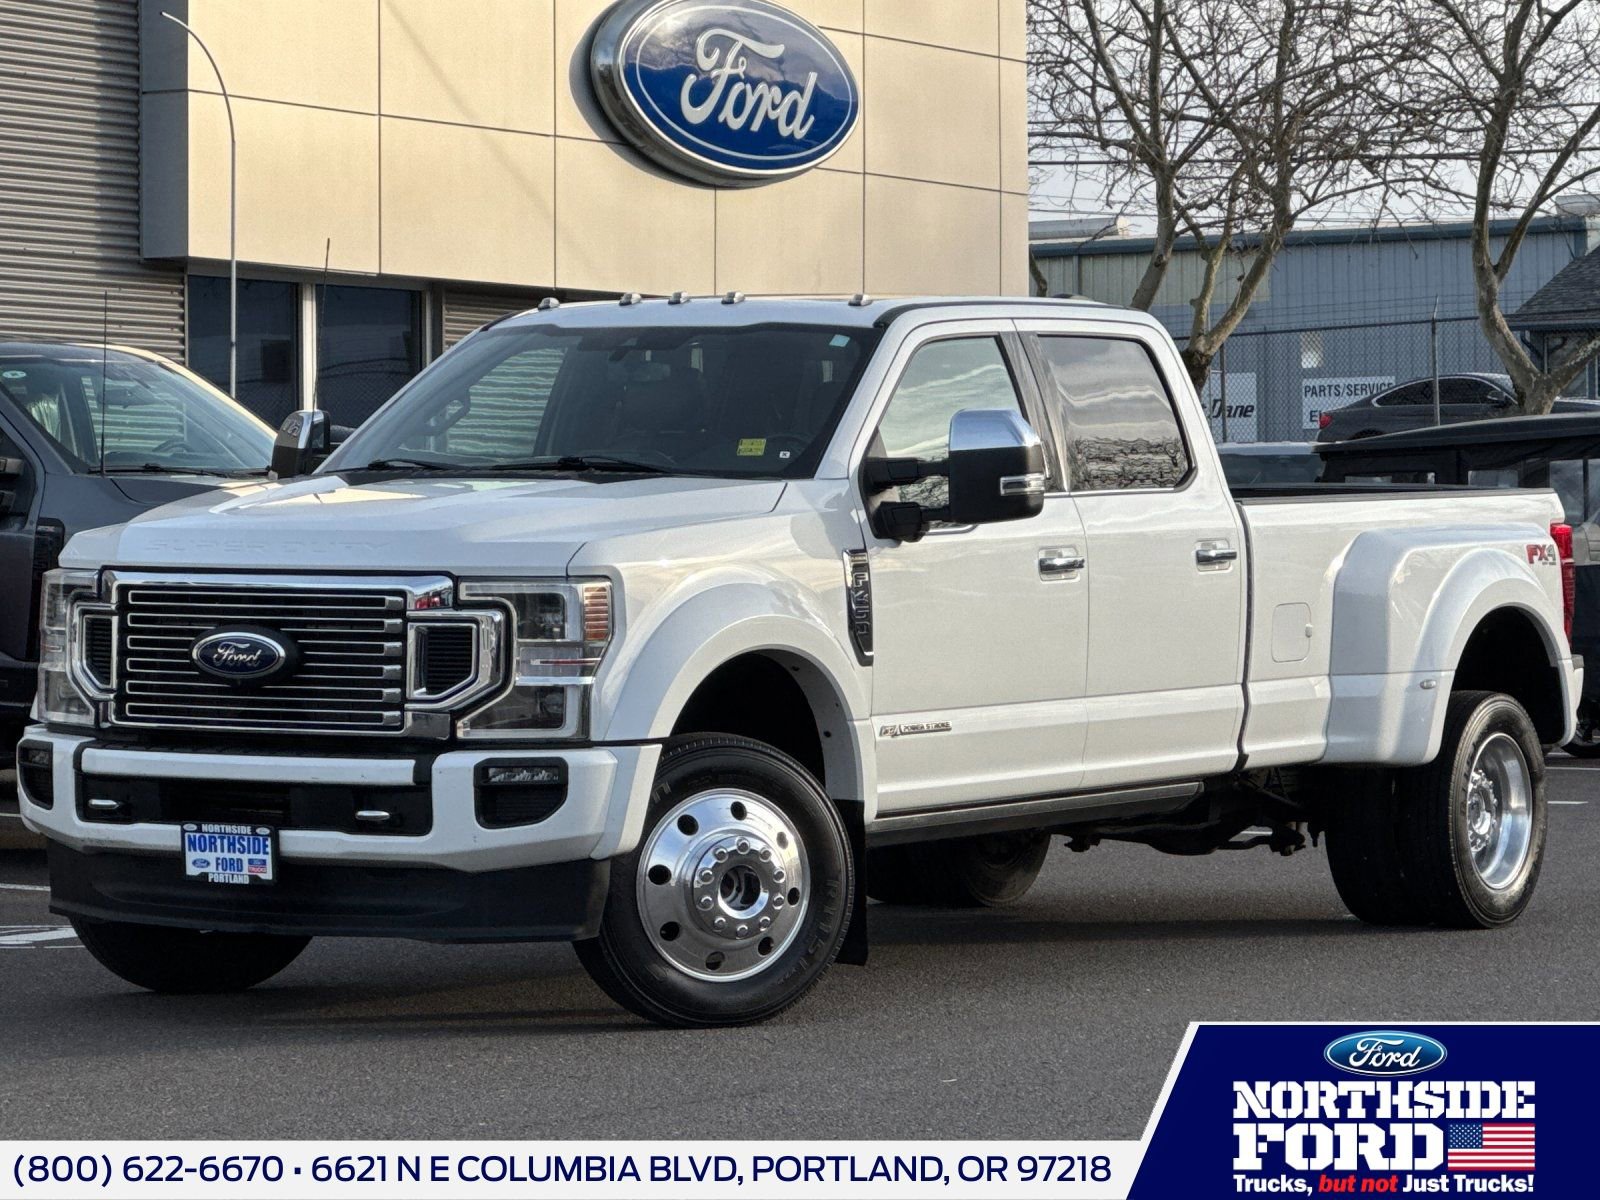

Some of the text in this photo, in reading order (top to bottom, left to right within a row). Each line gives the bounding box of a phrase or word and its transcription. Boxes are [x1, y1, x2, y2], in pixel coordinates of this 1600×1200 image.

[680, 28, 817, 140] Ford
[1526, 544, 1556, 564] FX4
[213, 641, 262, 668] Ford
[201, 824, 252, 834] NORTHSIDE
[187, 834, 269, 855] NORTHSIDE
[215, 857, 244, 872] FORD
[208, 873, 250, 884] PORTLAND
